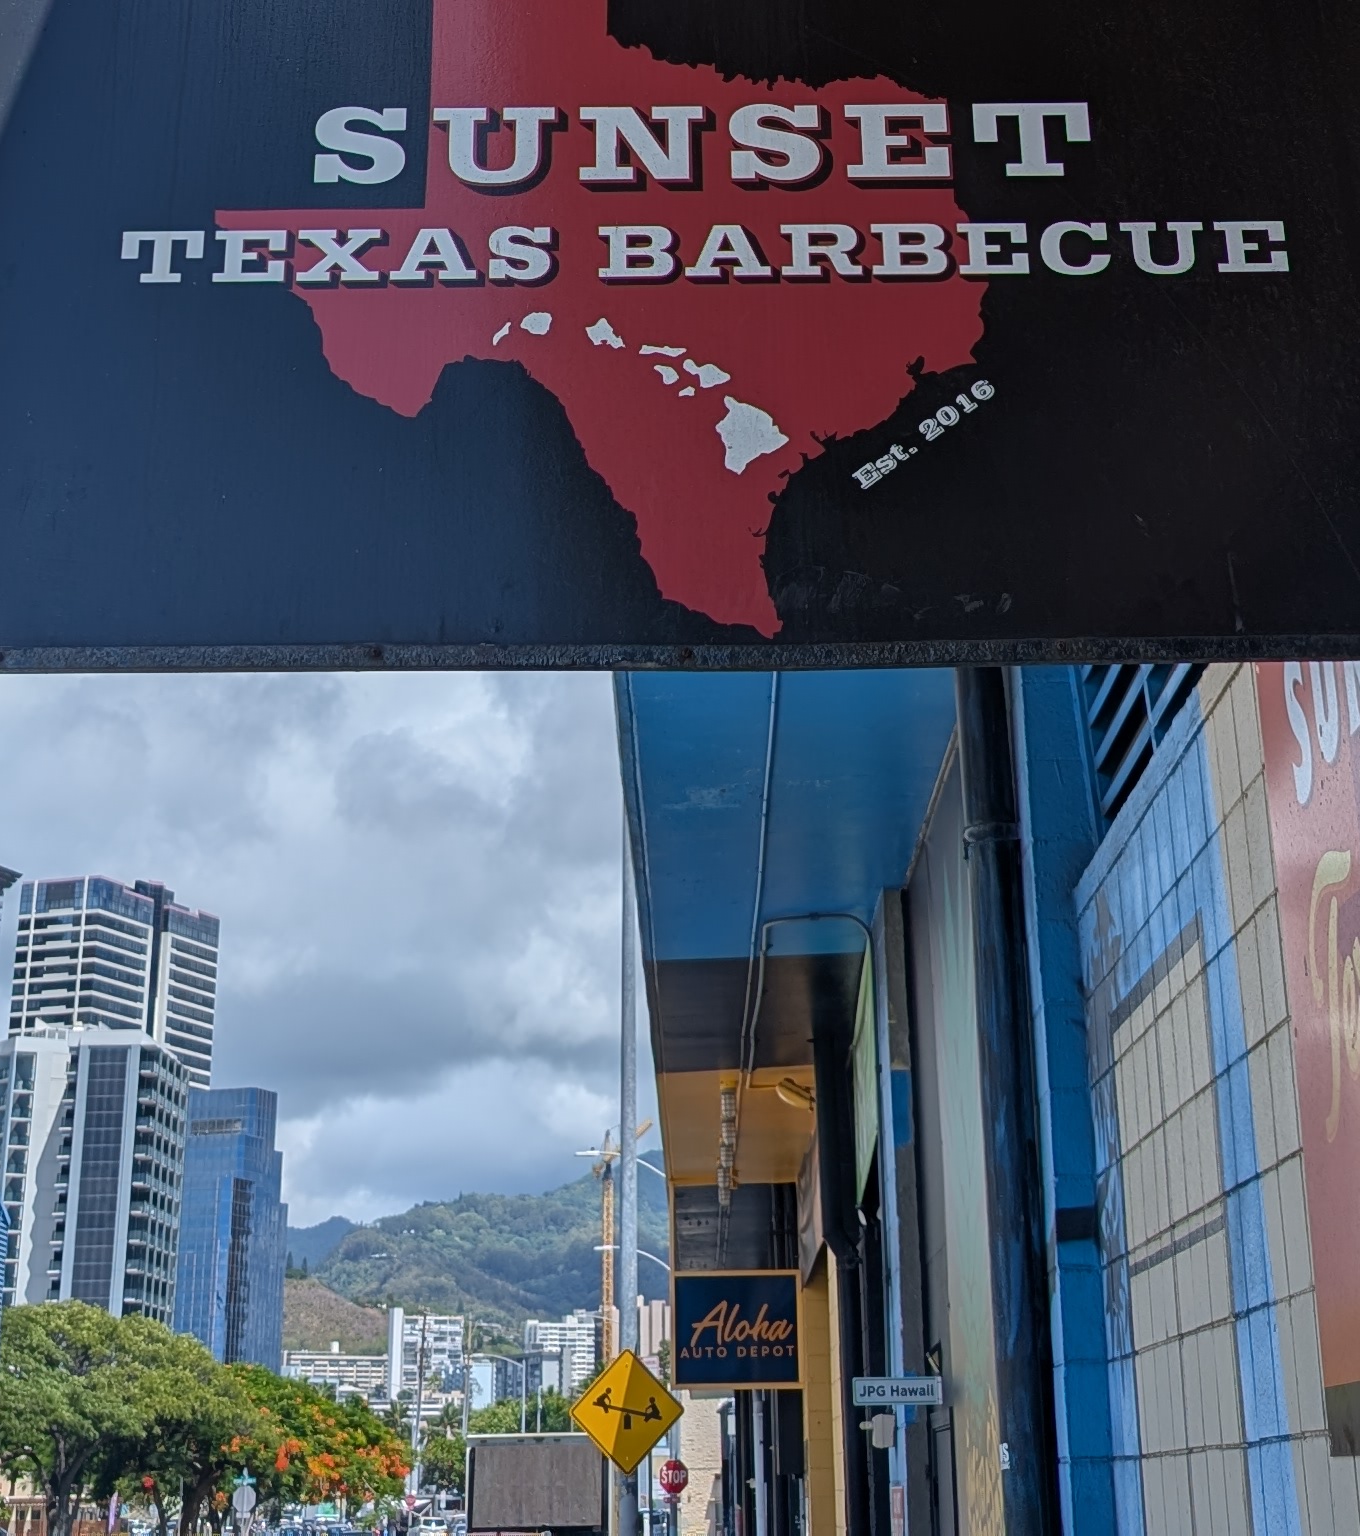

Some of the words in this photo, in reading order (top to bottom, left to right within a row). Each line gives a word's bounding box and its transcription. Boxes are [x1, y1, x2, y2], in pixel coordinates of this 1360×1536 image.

[313, 102, 1093, 189] SUNSET
[122, 226, 554, 286] TEXAS
[597, 221, 1291, 281] BARBECUE
[852, 444, 918, 490] Est.
[918, 379, 995, 442] 2016
[690, 1300, 793, 1348] Aloha
[680, 1346, 728, 1359] AUTO
[736, 1345, 795, 1358] DEPOT
[859, 1384, 886, 1398] JPG
[890, 1384, 935, 1398] Hawaii
[660, 1469, 687, 1484] STOP
